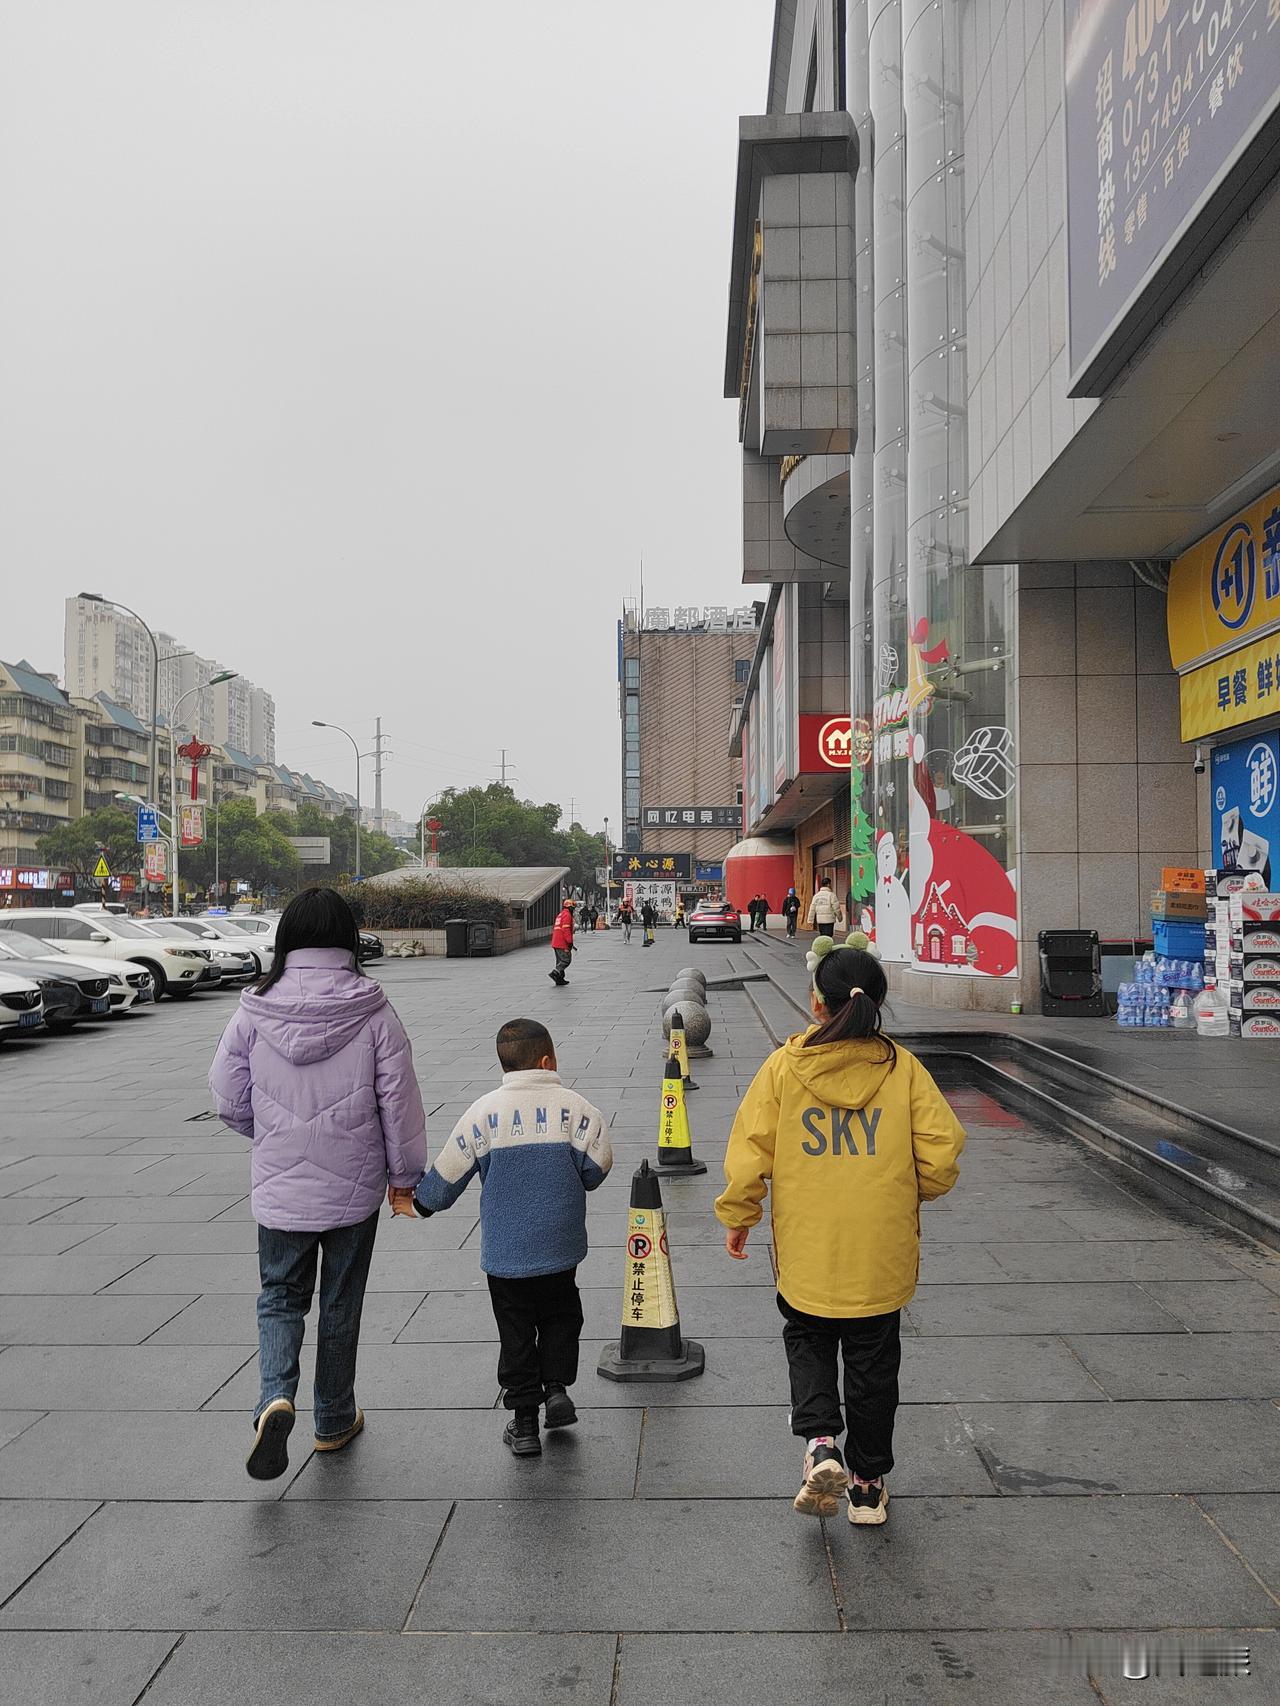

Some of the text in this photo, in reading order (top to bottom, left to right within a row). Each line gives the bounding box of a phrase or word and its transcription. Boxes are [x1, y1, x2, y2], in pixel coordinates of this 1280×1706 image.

[1123, 0, 1244, 194] 1397494104
[1096, 49, 1117, 287] 招商热线
[1217, 668, 1247, 712] 早餐
[1249, 749, 1274, 813] 鲜
[648, 810, 713, 824] 回忆电竞
[635, 883, 673, 895] 金信源
[1252, 897, 1280, 908] 娃哈哈
[664, 1110, 674, 1145] 禁止停车
[801, 1107, 882, 1156] SKY
[631, 1262, 646, 1322] 禁止停车
